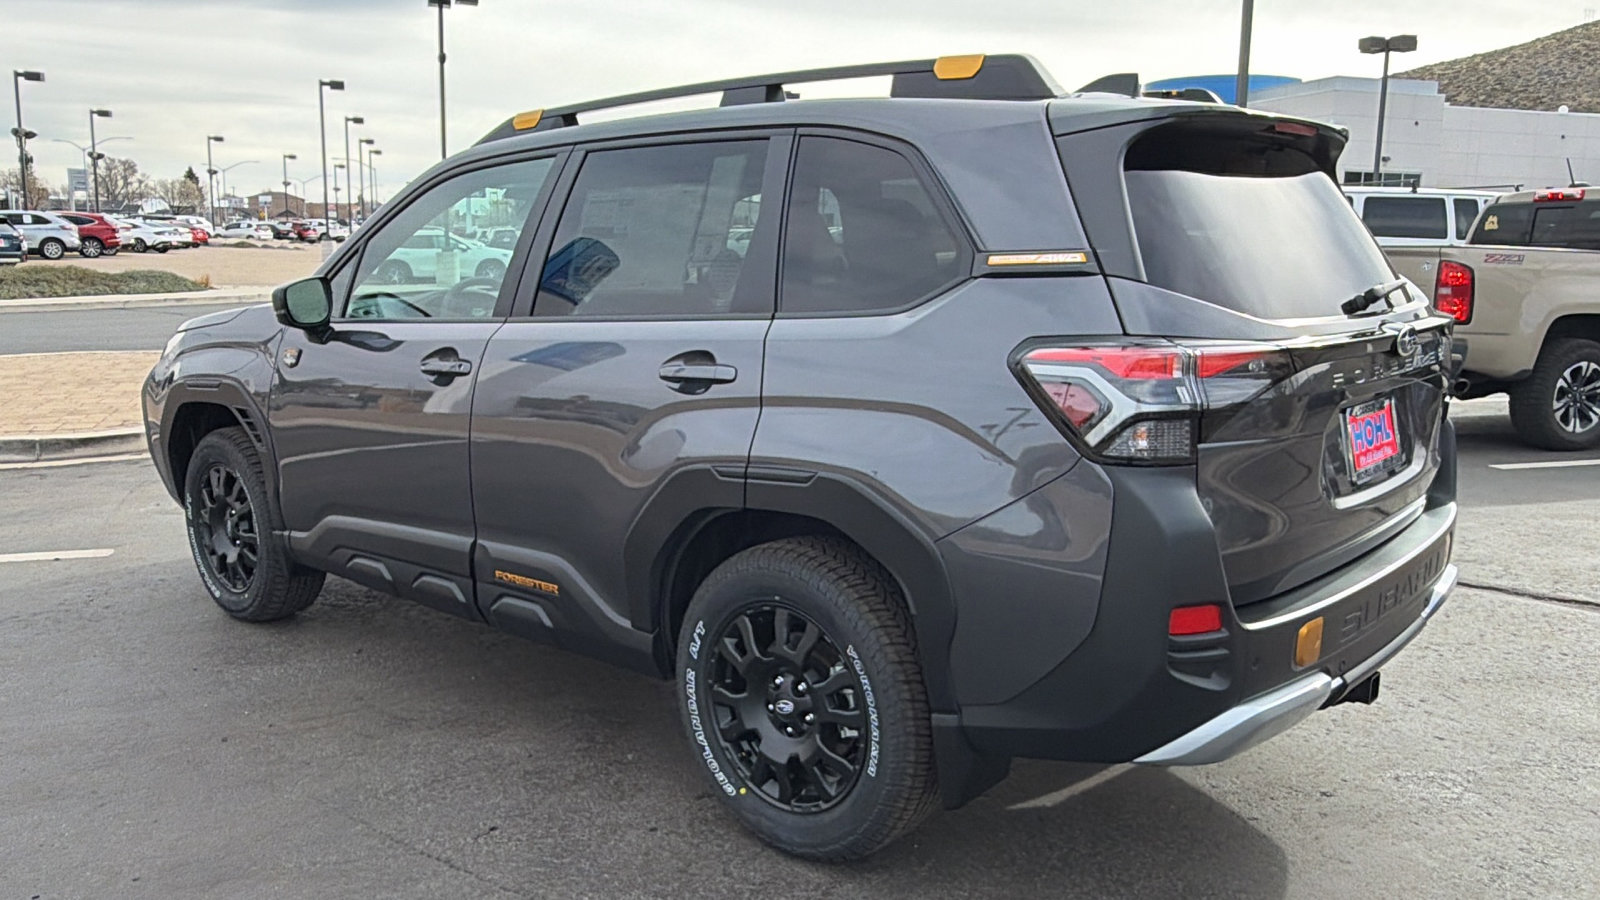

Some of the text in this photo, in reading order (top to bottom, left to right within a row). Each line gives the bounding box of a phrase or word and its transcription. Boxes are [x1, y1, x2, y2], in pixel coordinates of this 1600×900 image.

[1351, 412, 1393, 454] HOHL
[494, 569, 559, 597] FORESTER
[1340, 551, 1441, 643] SUBARU
[686, 620, 736, 796] GEOLANDAR A/T
[847, 644, 880, 777] YOKOHAMA
